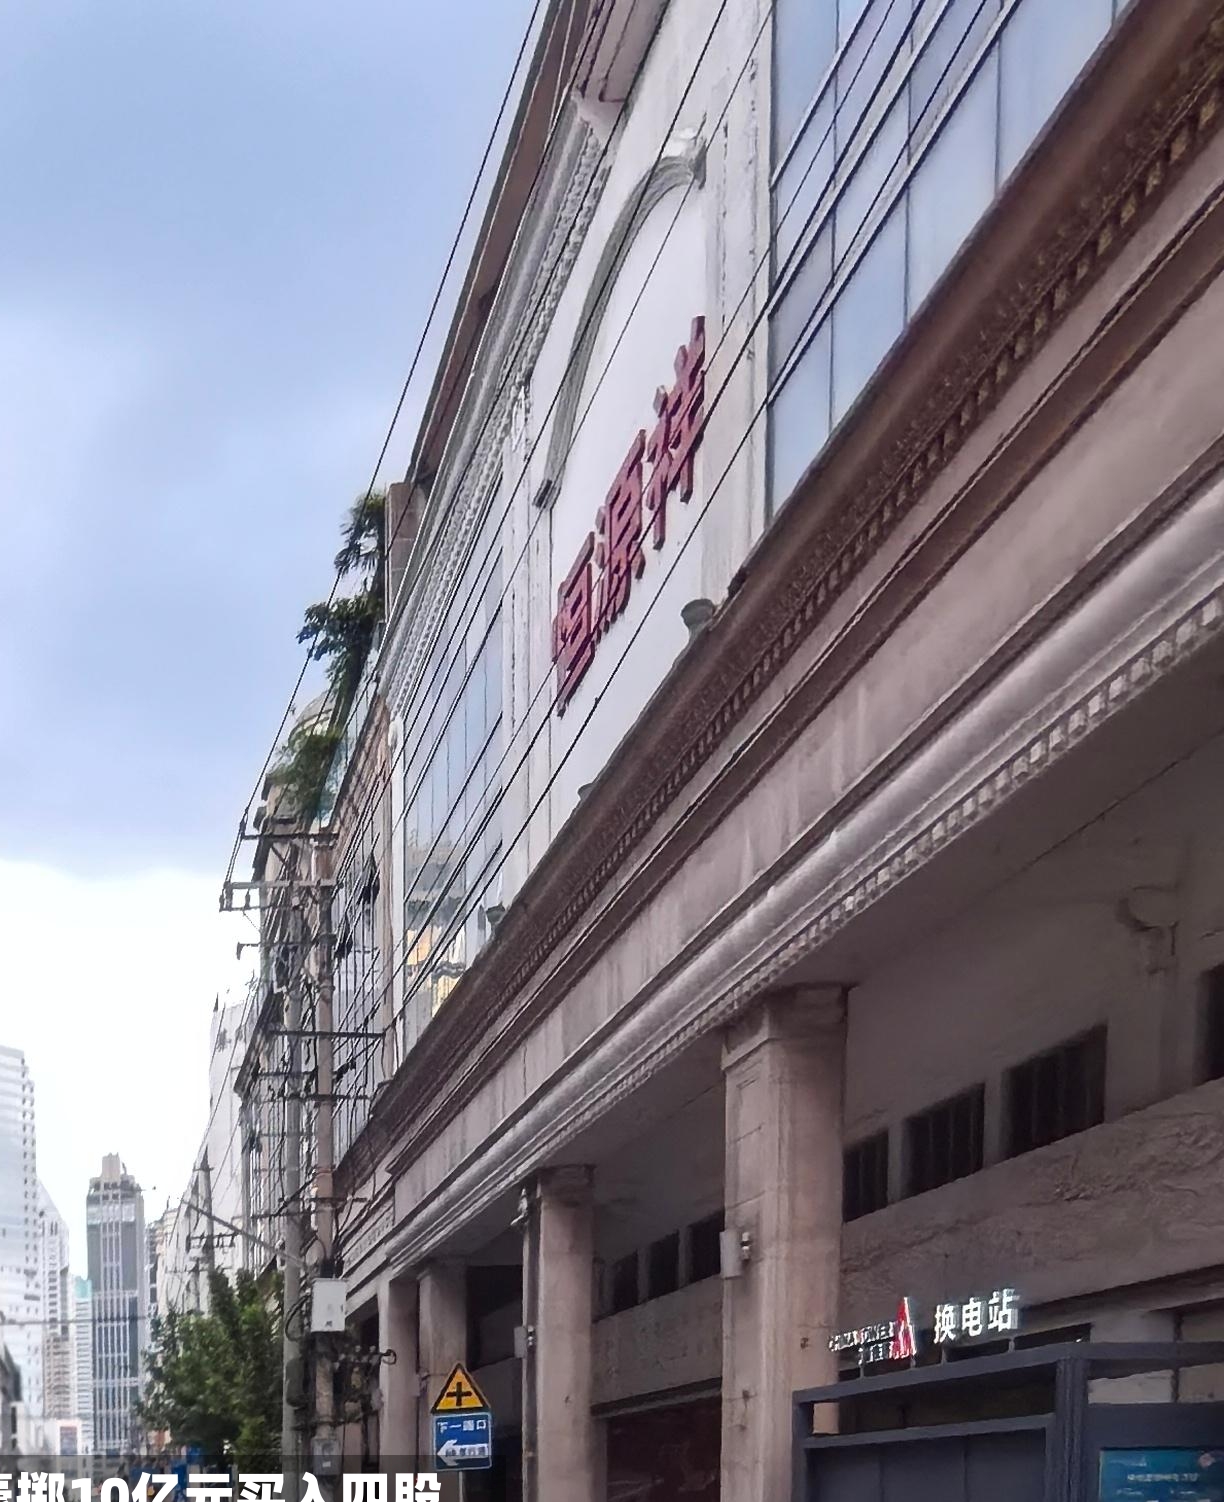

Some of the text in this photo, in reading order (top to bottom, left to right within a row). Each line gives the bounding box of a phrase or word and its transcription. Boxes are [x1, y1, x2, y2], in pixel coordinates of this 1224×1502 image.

[553, 316, 705, 718] 恒源祥
[933, 1288, 1018, 1344] 换电站
